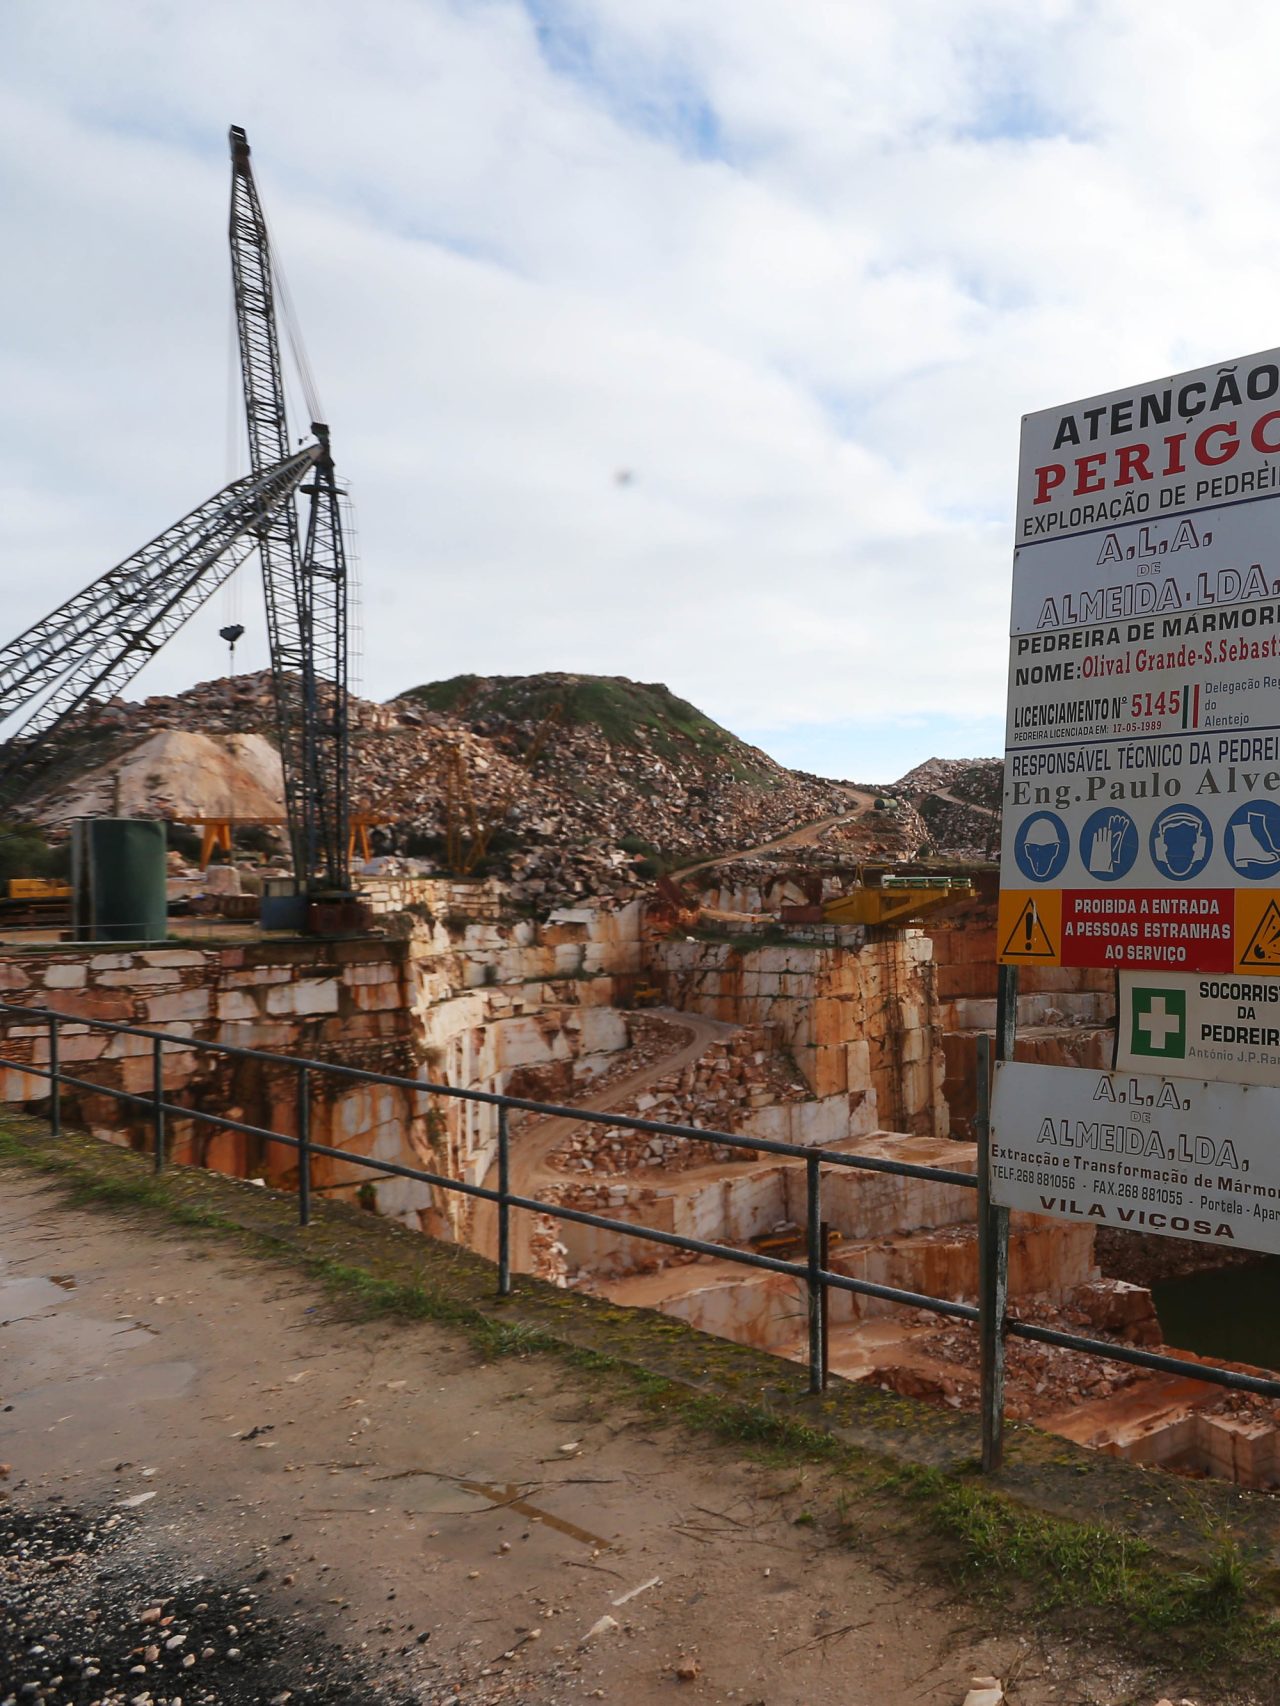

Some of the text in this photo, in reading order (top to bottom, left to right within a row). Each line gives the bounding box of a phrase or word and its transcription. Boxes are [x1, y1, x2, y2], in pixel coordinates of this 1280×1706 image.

[1052, 364, 1280, 450] ATENÇÃO
[1023, 490, 1150, 537] EXPLORAÇÃO
[1160, 485, 1186, 508] DE
[1137, 562, 1161, 577] DE
[1017, 627, 1121, 656] PEDREIRA
[1127, 622, 1155, 643] DE
[1205, 678, 1260, 695] Delegação
[1014, 697, 1109, 729] LICENCIAMENTO
[1131, 690, 1180, 718] 5145
[1204, 699, 1217, 711] do
[1050, 726, 1094, 739] LICENCIADA
[1112, 720, 1162, 734] 17-05-1989
[1204, 713, 1249, 727] Alentejo
[1012, 746, 1111, 777] RESPONSÁVEL
[1118, 742, 1182, 770] TÉCNICO
[1189, 741, 1212, 765] DA
[1074, 899, 1220, 915] PROIBIDA A ENTRADA
[1065, 922, 1231, 940] A PESSOAS ESTRANHAS
[1105, 945, 1187, 964] AO SERVIÇO
[1237, 1005, 1256, 1020] DA
[1188, 1046, 1234, 1061] António
[1130, 1111, 1151, 1123] DE
[991, 1143, 1059, 1167] Extracção
[1062, 1158, 1070, 1168] e
[1073, 1155, 1188, 1185] Transformação
[1194, 1173, 1213, 1188] de
[1037, 1172, 1075, 1190] 881056
[1141, 1186, 1183, 1206] 881055
[1200, 1195, 1243, 1215] Portela
[1040, 1195, 1235, 1240] VILA VIÇOSA
